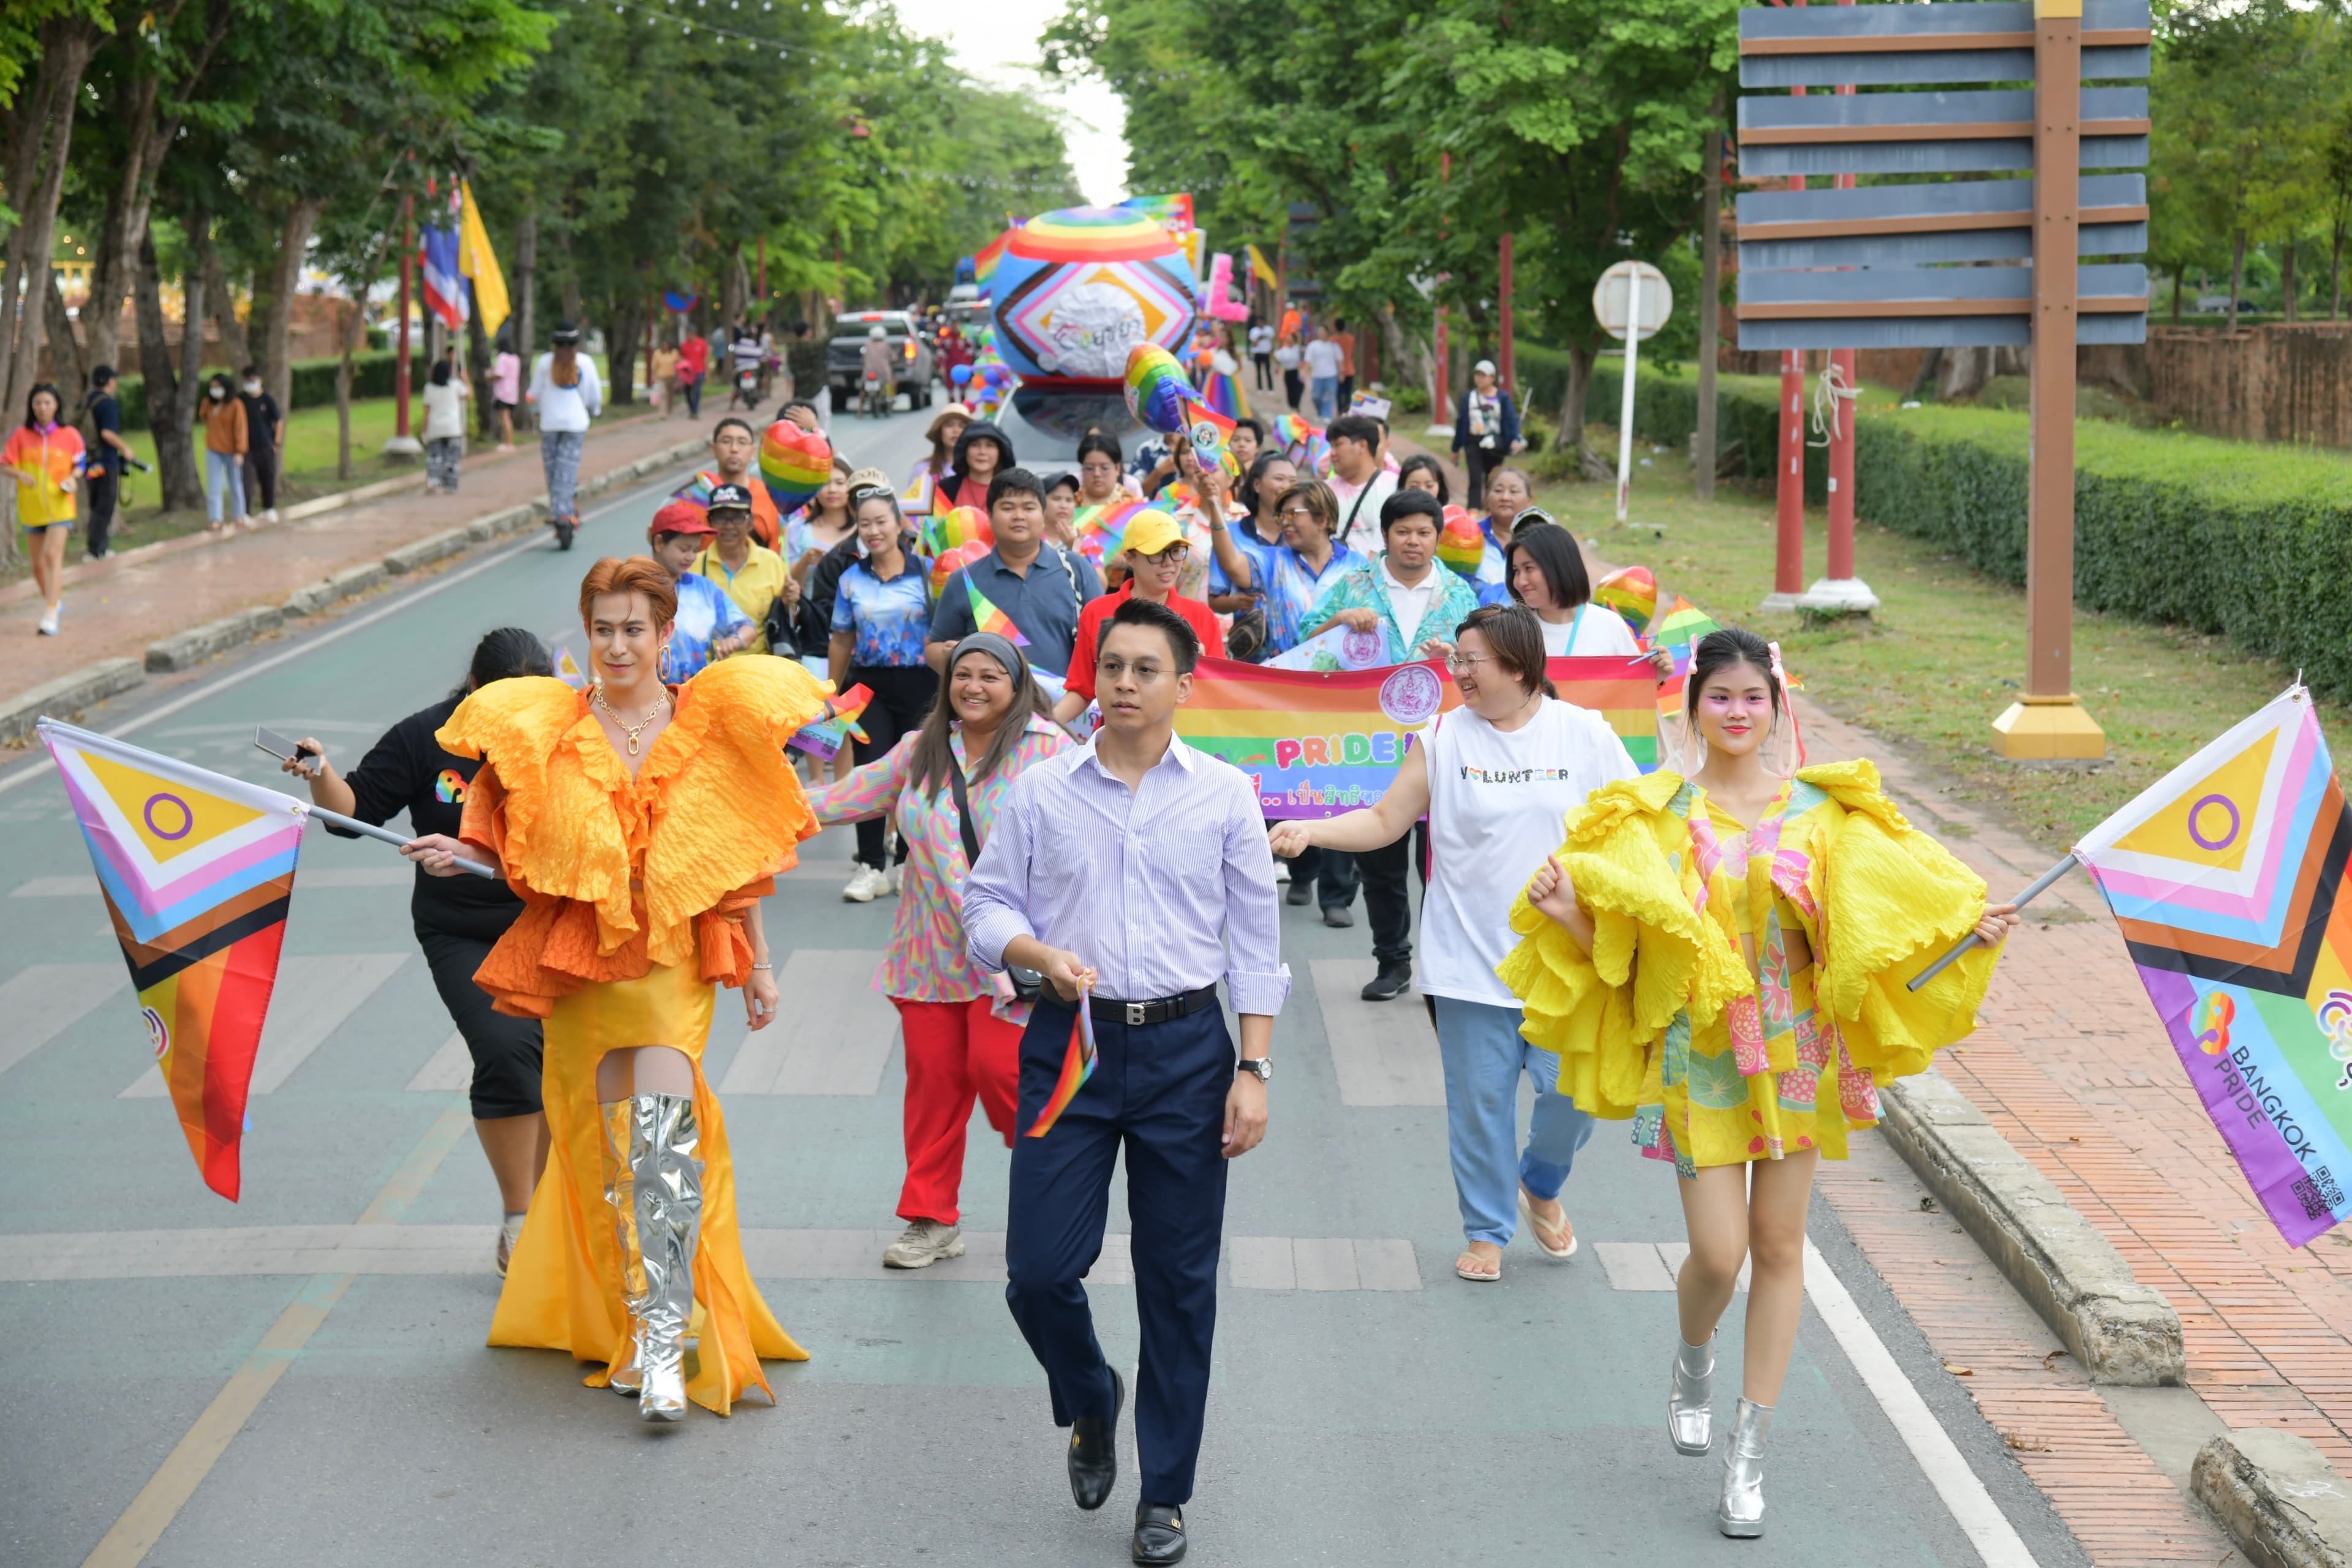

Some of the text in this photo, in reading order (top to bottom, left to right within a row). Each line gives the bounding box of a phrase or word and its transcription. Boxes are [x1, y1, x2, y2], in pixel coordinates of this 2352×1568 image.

[1275, 732, 1397, 771] PRIDE
[1287, 780, 1387, 807] เป็นสิทธิขอ
[2214, 1058, 2268, 1130] PRIDE
[2232, 1046, 2317, 1163] BANGKOK
